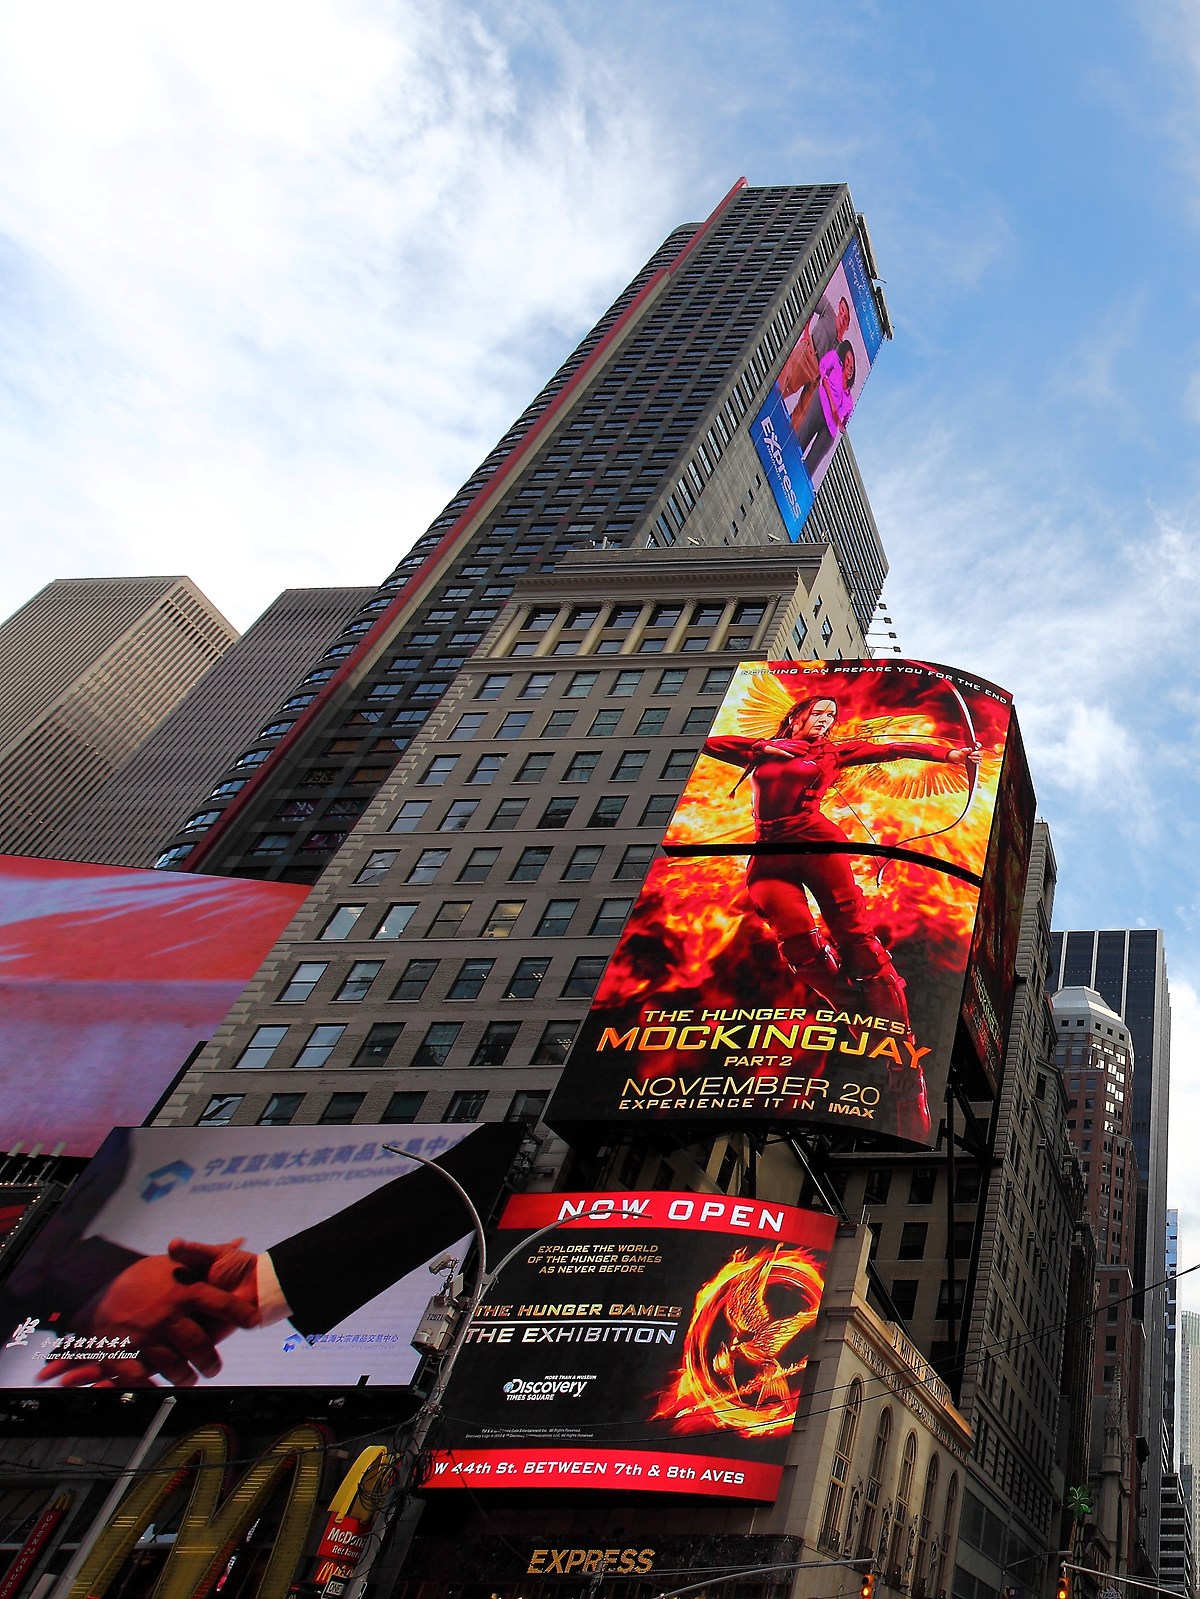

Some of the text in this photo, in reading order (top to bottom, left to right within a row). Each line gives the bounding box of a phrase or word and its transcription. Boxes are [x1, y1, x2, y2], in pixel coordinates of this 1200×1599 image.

[741, 666, 1008, 705] NOTHING CAN PREPARE YOU FOR THE END
[644, 1008, 912, 1035] THE HUNGER GAMES:
[597, 1024, 933, 1069] MOCKINGJAY
[724, 1055, 793, 1067] PART 2
[621, 1076, 881, 1106] NOVEMBER 20
[618, 1098, 876, 1119] EXPERIENCE IT IN IMAX
[556, 1199, 785, 1232] NOW OPEN
[527, 1254, 663, 1264] OF THE HUNGER GAMES
[537, 1244, 660, 1254] EXPLORE THE WORLD
[538, 1265, 645, 1274] AS NEVER BEFORE
[474, 1303, 682, 1318] THE HUNGER GAMES
[465, 1326, 676, 1344] THE EXHIBITION
[61, 1350, 74, 1360] the
[74, 1350, 108, 1362] security
[108, 1350, 121, 1360] of
[118, 1350, 140, 1360] fund
[526, 1393, 555, 1401] SQUARE
[433, 1462, 745, 1484] W 44th St. BETWEEN 7th & 8th AVES
[32, 1515, 53, 1545] OPEN
[527, 1548, 655, 1575] EXPRESS
